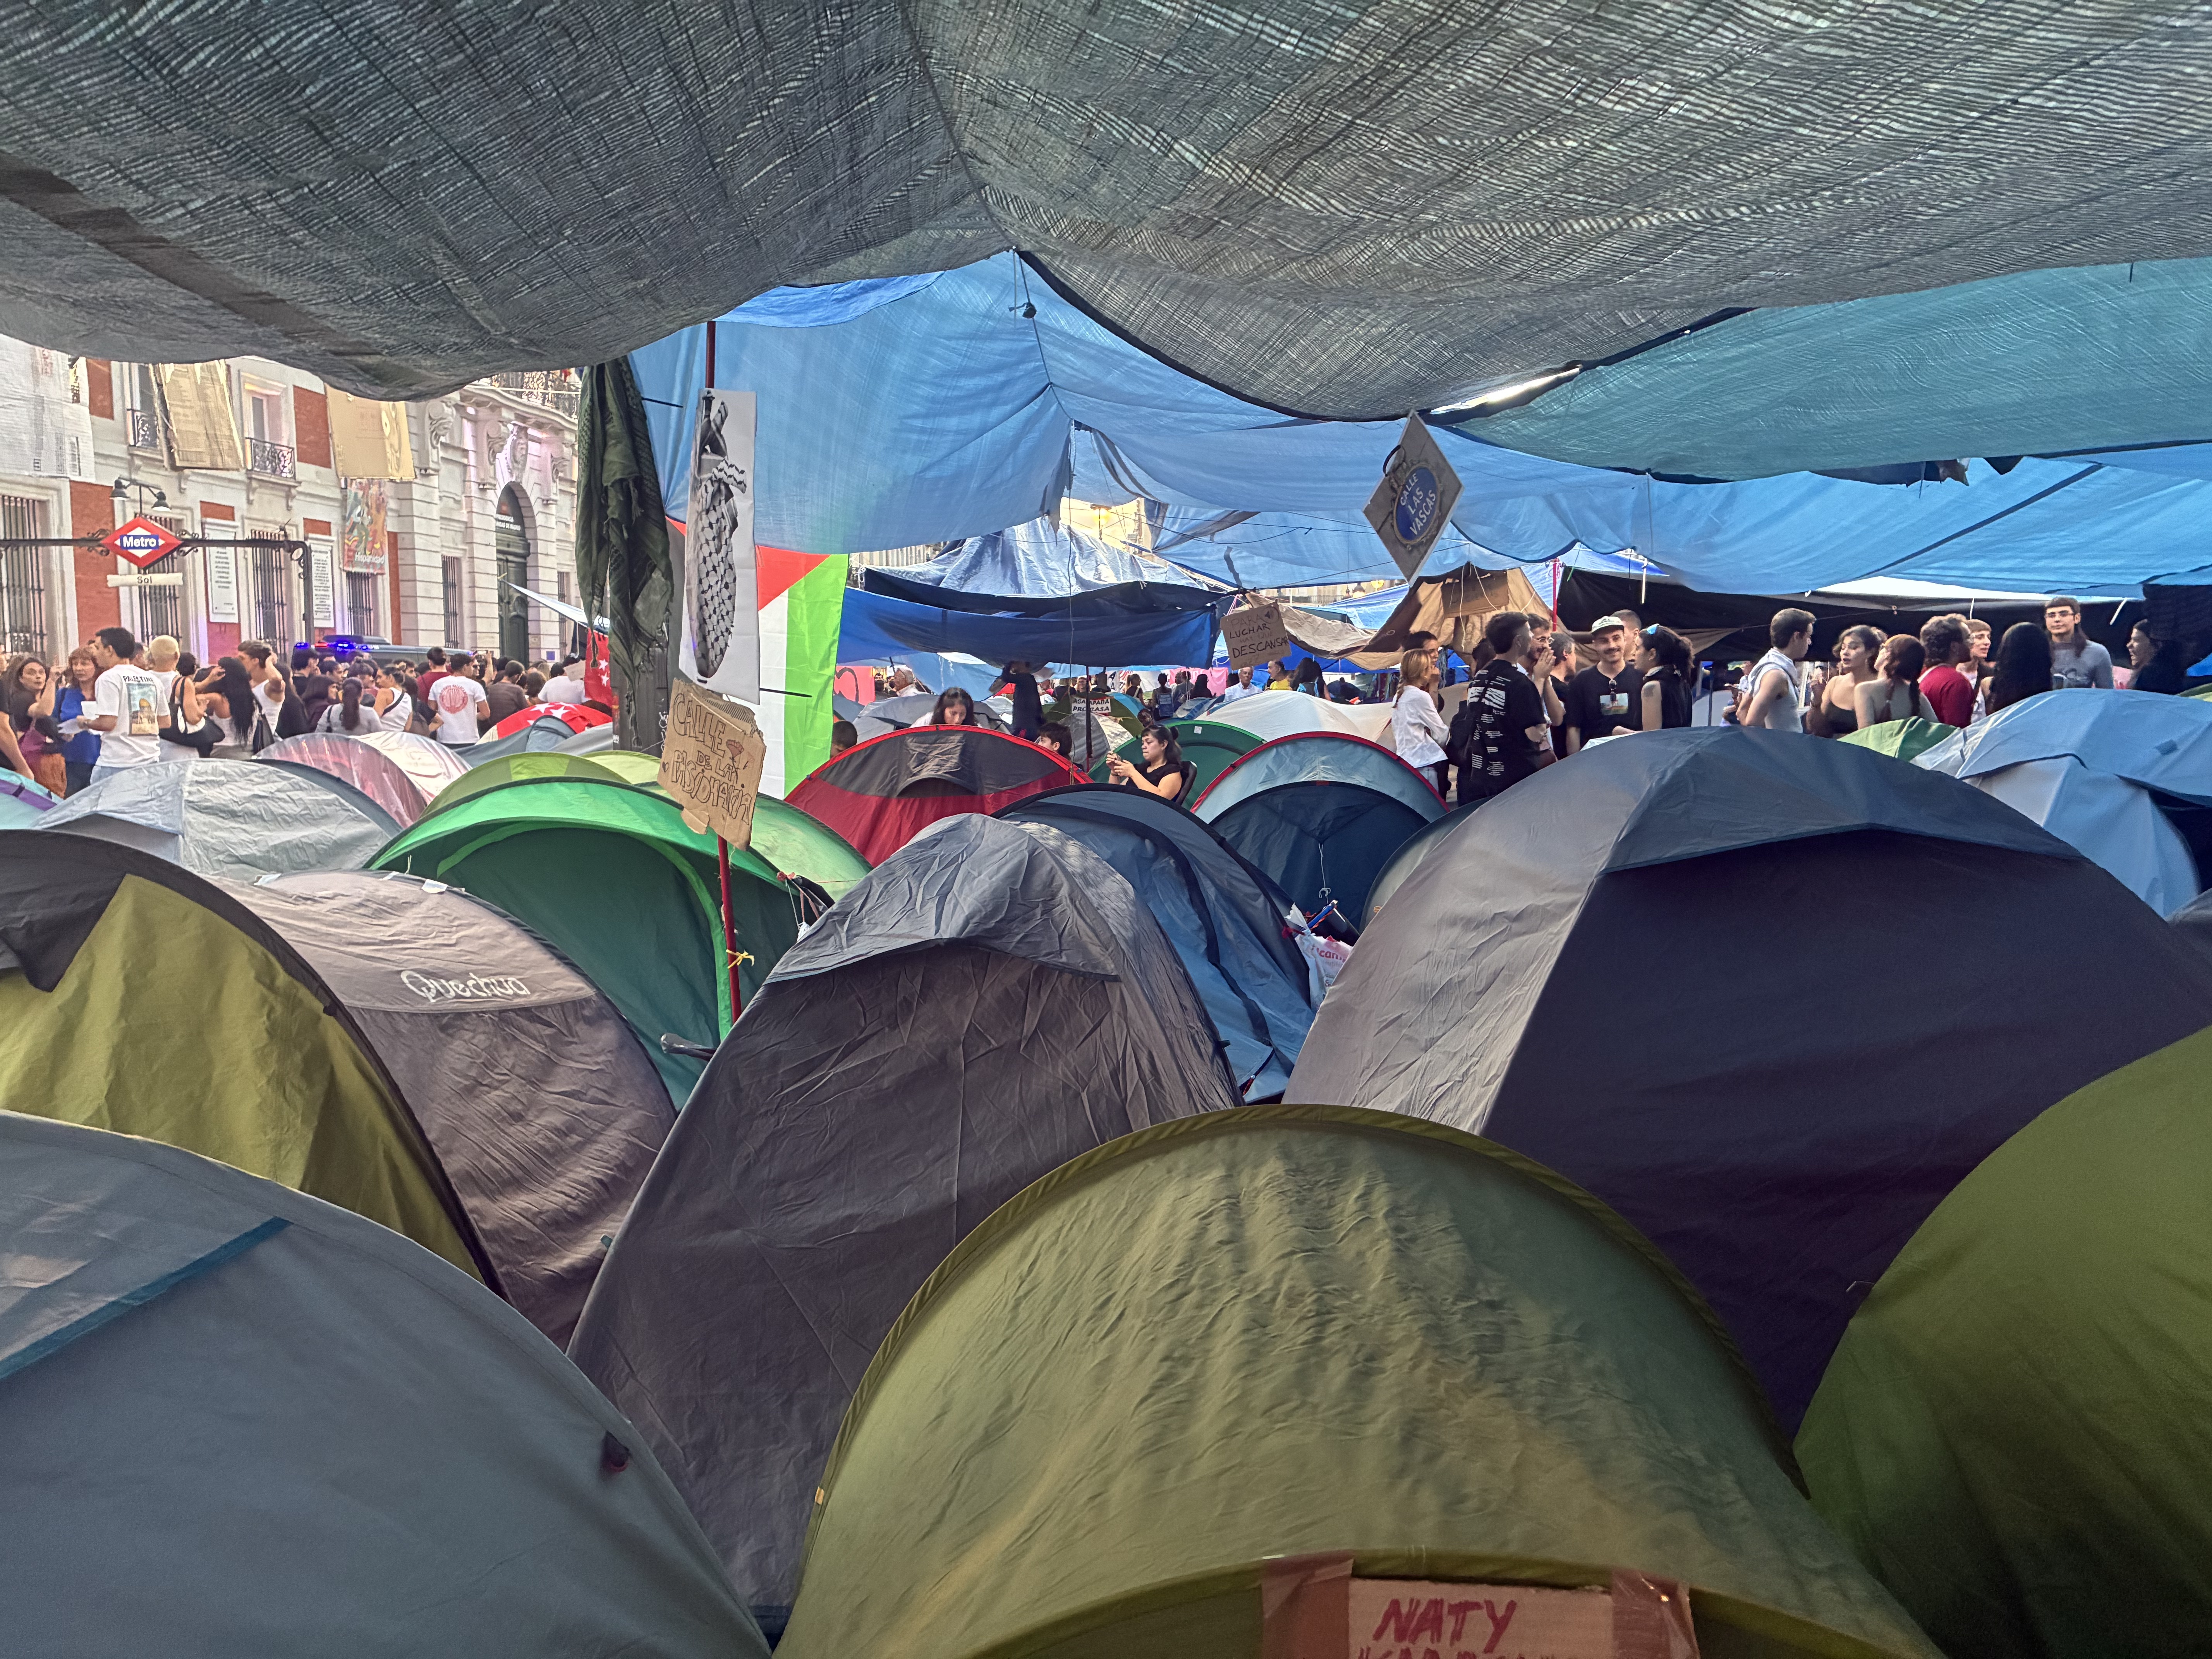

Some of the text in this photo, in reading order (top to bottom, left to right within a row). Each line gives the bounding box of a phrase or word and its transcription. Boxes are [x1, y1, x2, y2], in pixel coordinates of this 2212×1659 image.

[1400, 473, 1419, 506] CALLE
[1408, 487, 1423, 514] LAS
[1410, 489, 1436, 535] VASCAS
[123, 536, 156, 547] Metro
[137, 576, 152, 584] Sol
[1230, 623, 1271, 639] LUCHAR
[1231, 614, 1263, 628] PARA
[1232, 636, 1289, 658] DESCANSAR
[673, 693, 726, 758] CALLE
[697, 750, 734, 781] DE LA
[400, 970, 531, 1003] Quechua
[1373, 1598, 1517, 1653] NATY
